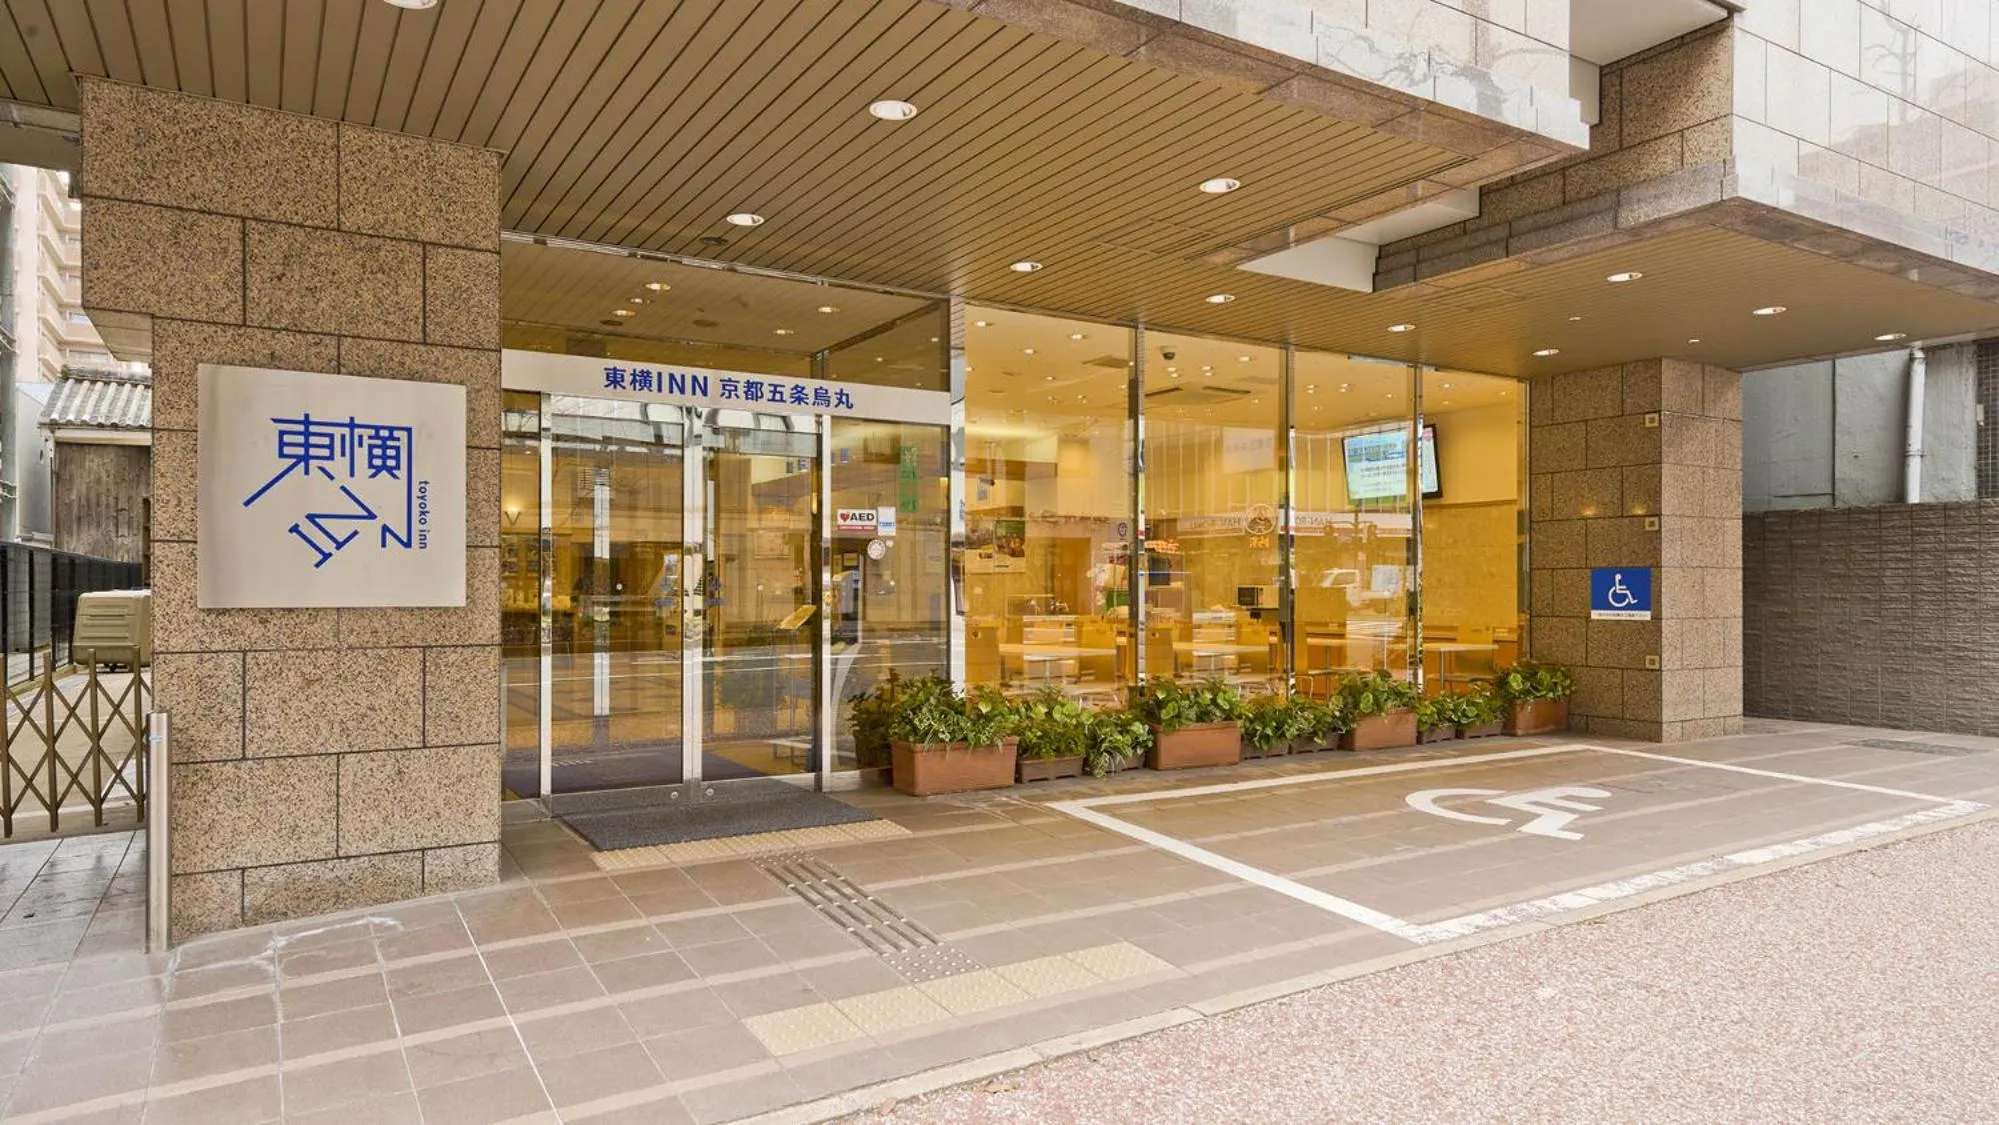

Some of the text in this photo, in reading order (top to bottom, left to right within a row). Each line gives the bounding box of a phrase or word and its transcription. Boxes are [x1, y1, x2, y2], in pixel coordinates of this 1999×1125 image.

[604, 367, 853, 409] 東横INN 京都五条烏丸
[417, 481, 429, 550] toyoko inn
[850, 512, 875, 521] AED
